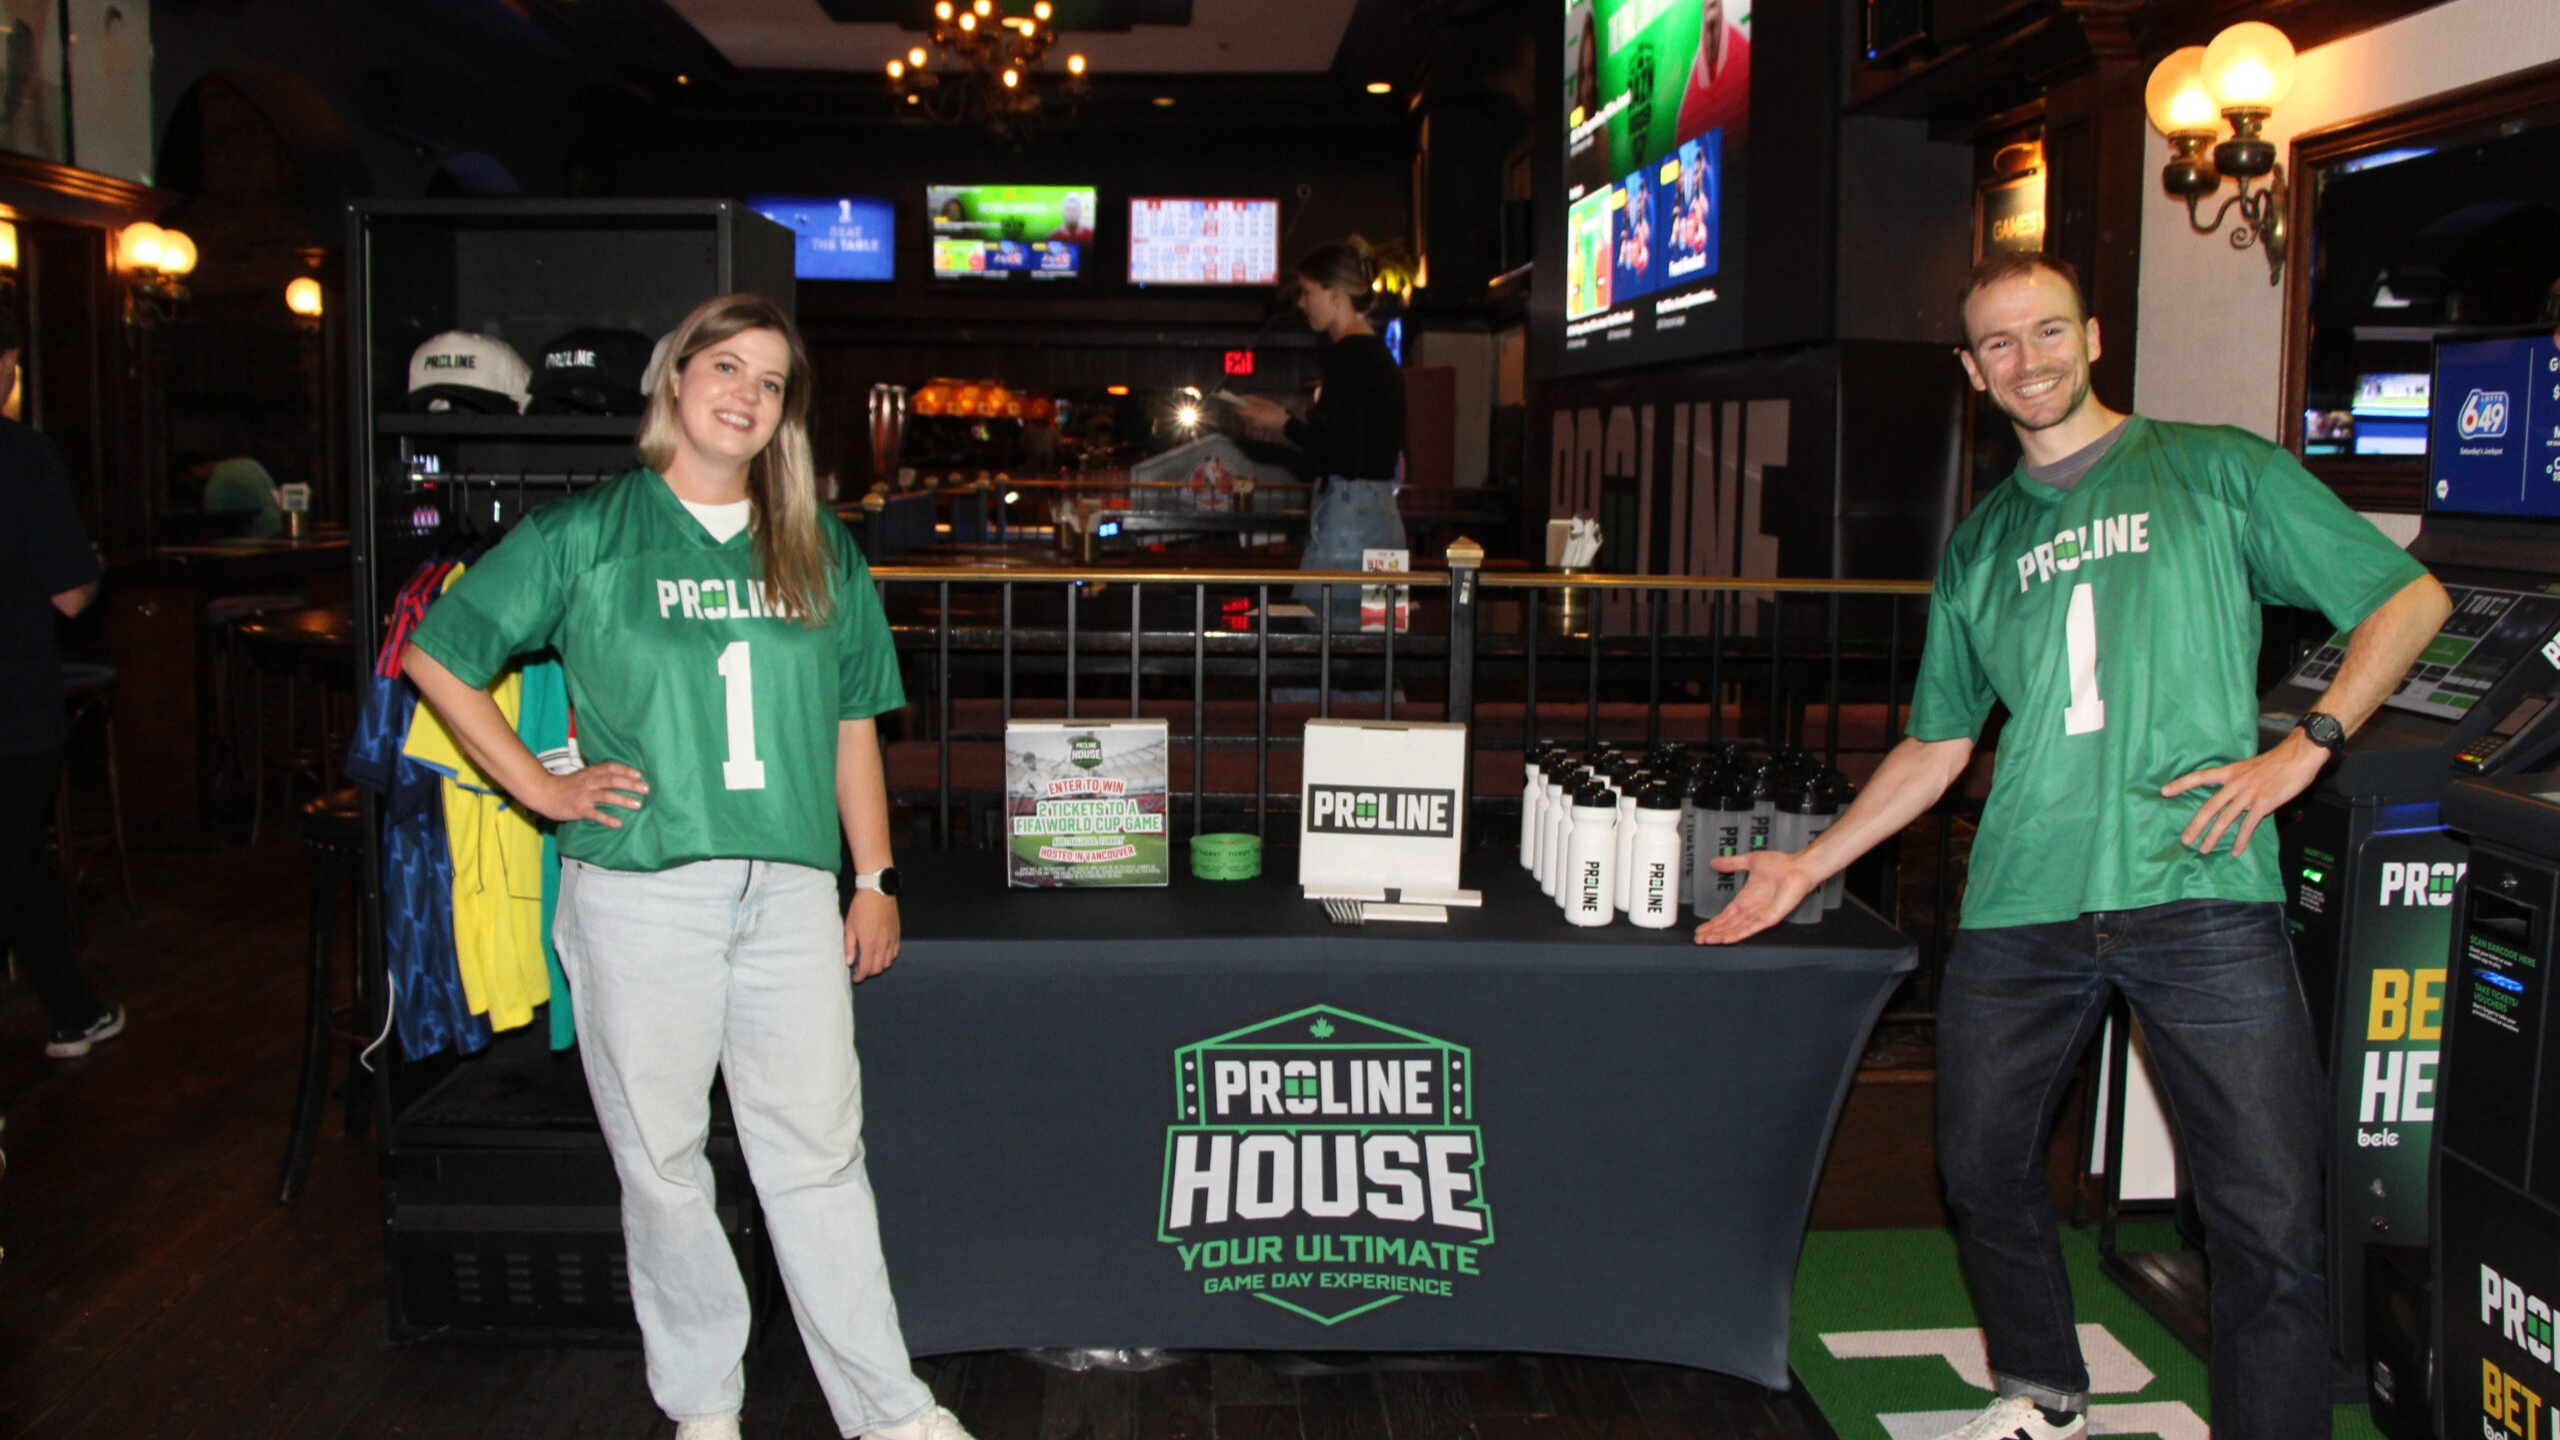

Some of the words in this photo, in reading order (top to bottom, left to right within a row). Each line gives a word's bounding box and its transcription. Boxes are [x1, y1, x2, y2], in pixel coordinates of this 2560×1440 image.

[424, 354, 476, 370] PROLINE
[546, 350, 596, 369] PROLINE
[2016, 511, 2150, 594] PROLINE
[2064, 582, 2105, 736] 1
[717, 640, 766, 790] 1
[1071, 749, 1102, 760] HOUSE
[1038, 803, 1048, 817] 2
[1050, 802, 1104, 817] TICKETS
[1109, 801, 1124, 815] TO
[1128, 801, 1138, 815] A
[1048, 779, 1082, 795] ENTER
[1086, 779, 1099, 792] TO
[1103, 779, 1125, 794] WIN
[1015, 818, 1042, 833] FIFA
[1045, 817, 1091, 832] WORLD
[1095, 816, 1121, 832] CUP
[1125, 815, 1160, 831] GAME
[1313, 790, 1448, 832] PROLINE
[1040, 848, 1073, 861] HOSTED
[1075, 851, 1083, 861] IN
[1085, 845, 1135, 861] VANCOUVER
[1717, 826, 1738, 892] PRONE
[1582, 860, 1600, 913] PROLINE
[1647, 863, 1665, 914] PROLINE
[2379, 862, 2467, 906] PRO
[2469, 934, 2487, 949] SCAN
[2366, 968, 2448, 1041] BE
[1214, 1059, 1433, 1115] PROLINE
[2359, 1050, 2440, 1122] HE
[1168, 1134, 1483, 1231] HOUSE
[1177, 1235, 1283, 1272] YOUR
[1295, 1234, 1481, 1276] ULTIMATE
[1203, 1273, 1265, 1294] GAME
[1271, 1272, 1314, 1288] DAY
[1319, 1272, 1454, 1297] EXPERIENCE
[2482, 1356, 2542, 1440] BET
